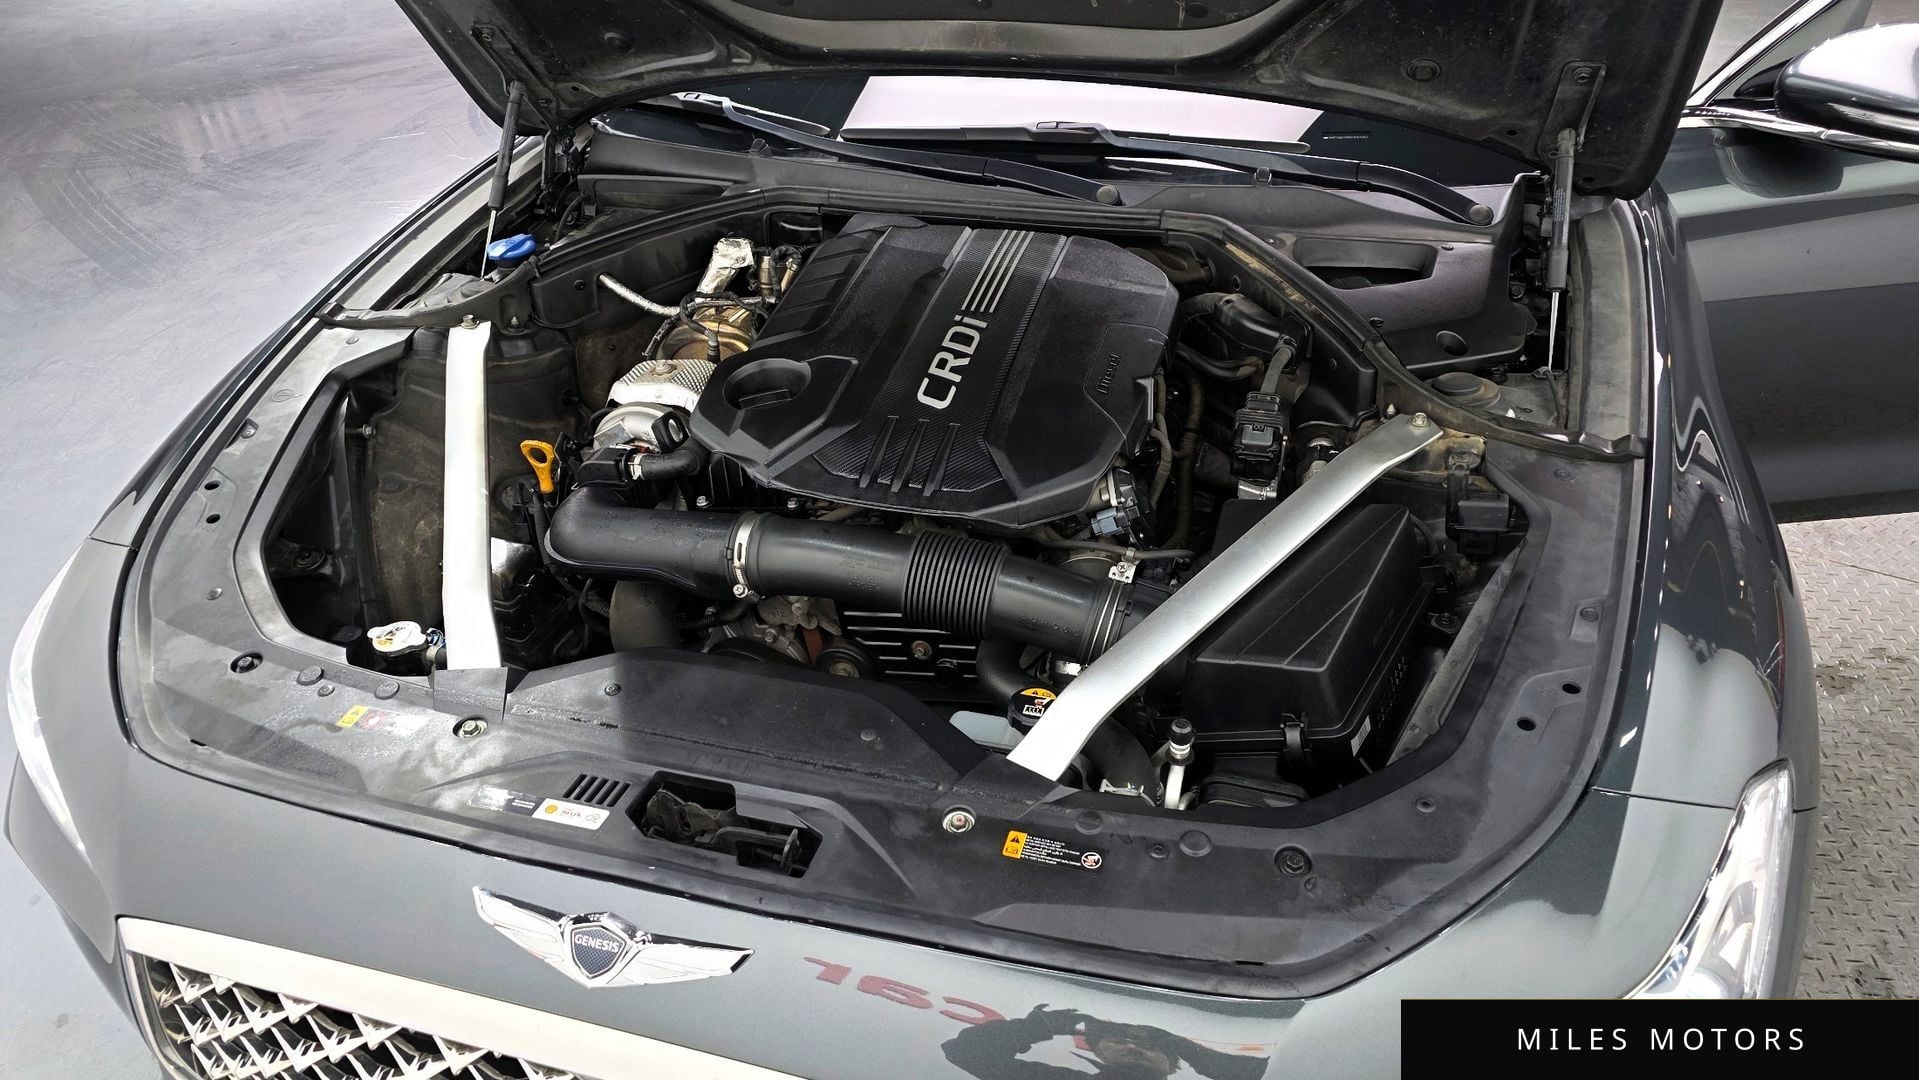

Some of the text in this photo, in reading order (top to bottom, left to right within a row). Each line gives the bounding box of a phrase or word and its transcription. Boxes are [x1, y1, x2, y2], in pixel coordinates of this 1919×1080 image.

[916, 315, 988, 410] CRDi
[1097, 352, 1122, 394] Diesel
[574, 933, 620, 953] GENESIS
